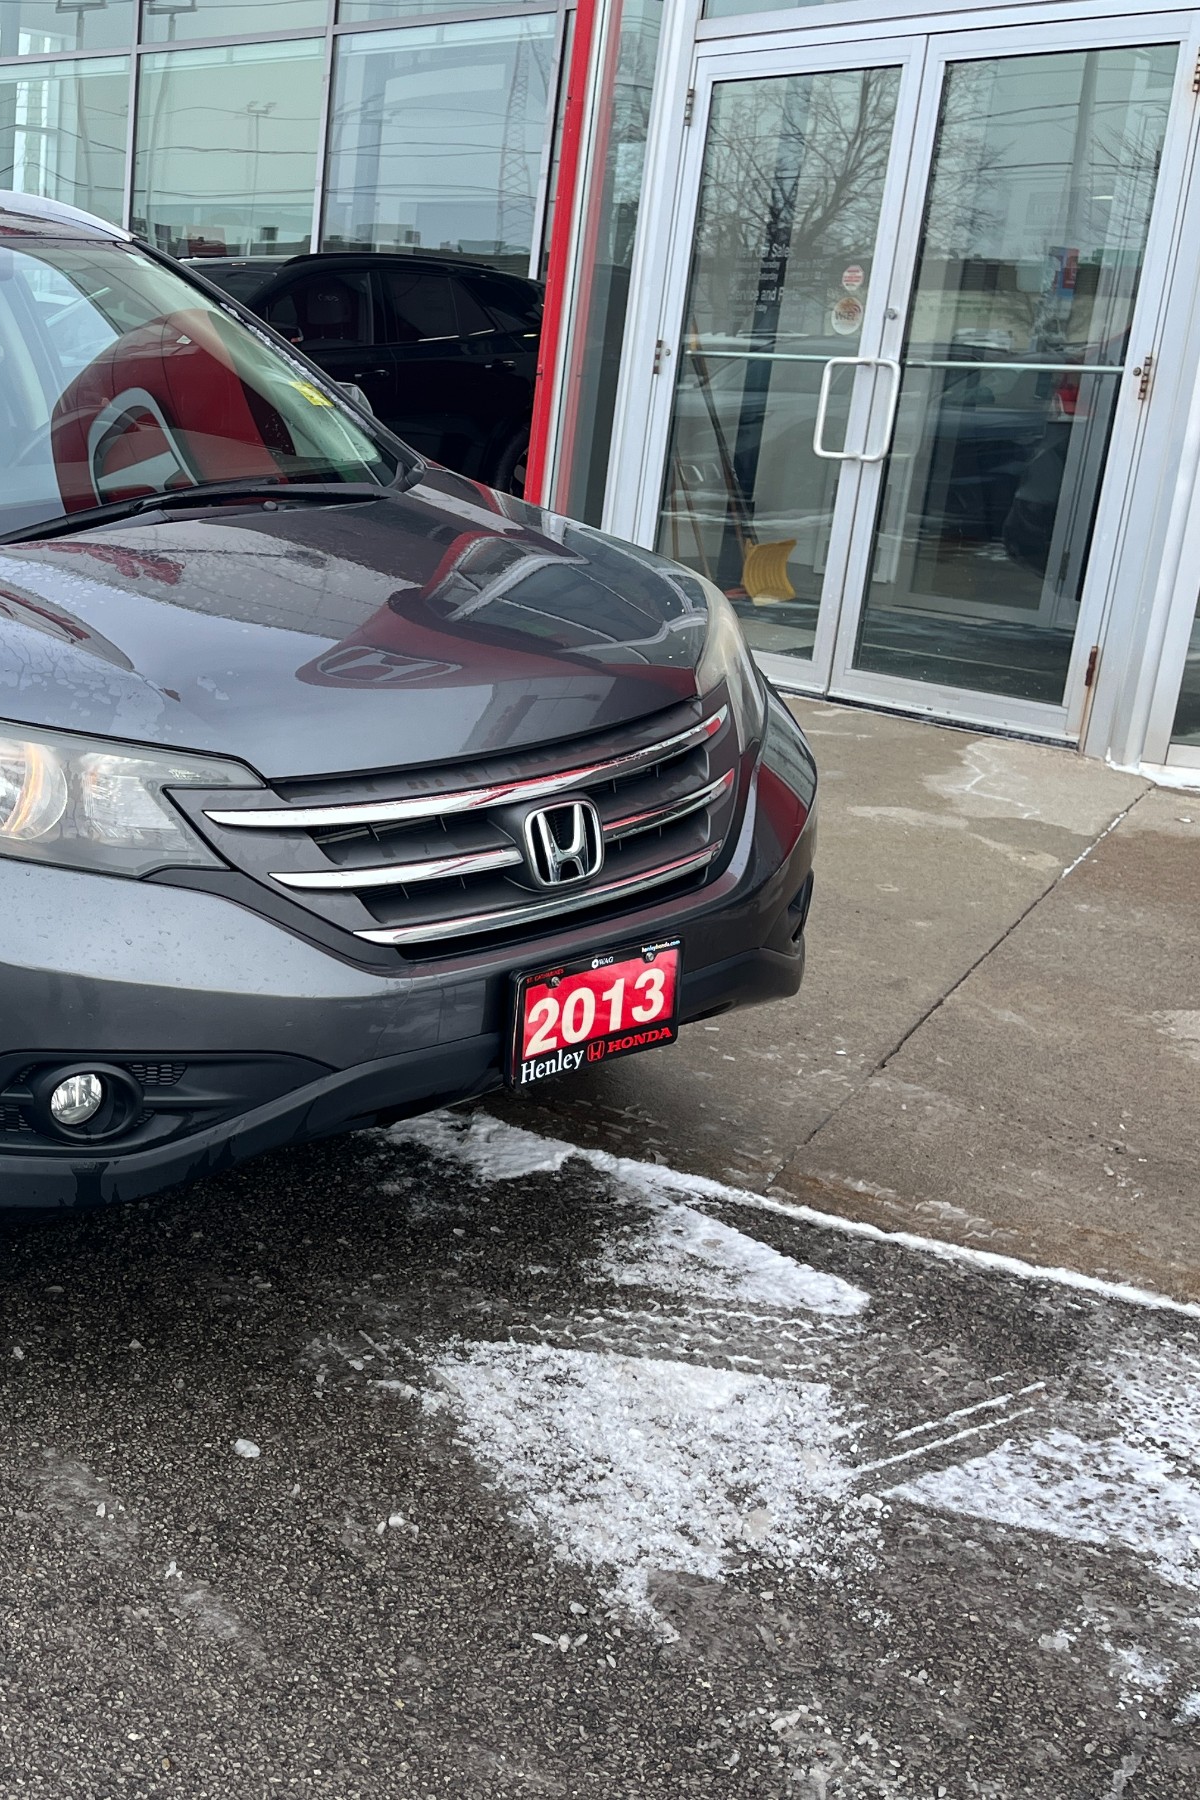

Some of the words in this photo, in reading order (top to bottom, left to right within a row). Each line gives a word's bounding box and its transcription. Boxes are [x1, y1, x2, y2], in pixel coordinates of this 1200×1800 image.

[525, 968, 666, 1057] 2013
[520, 1049, 585, 1085] Henley
[607, 1026, 673, 1053] HONDA
